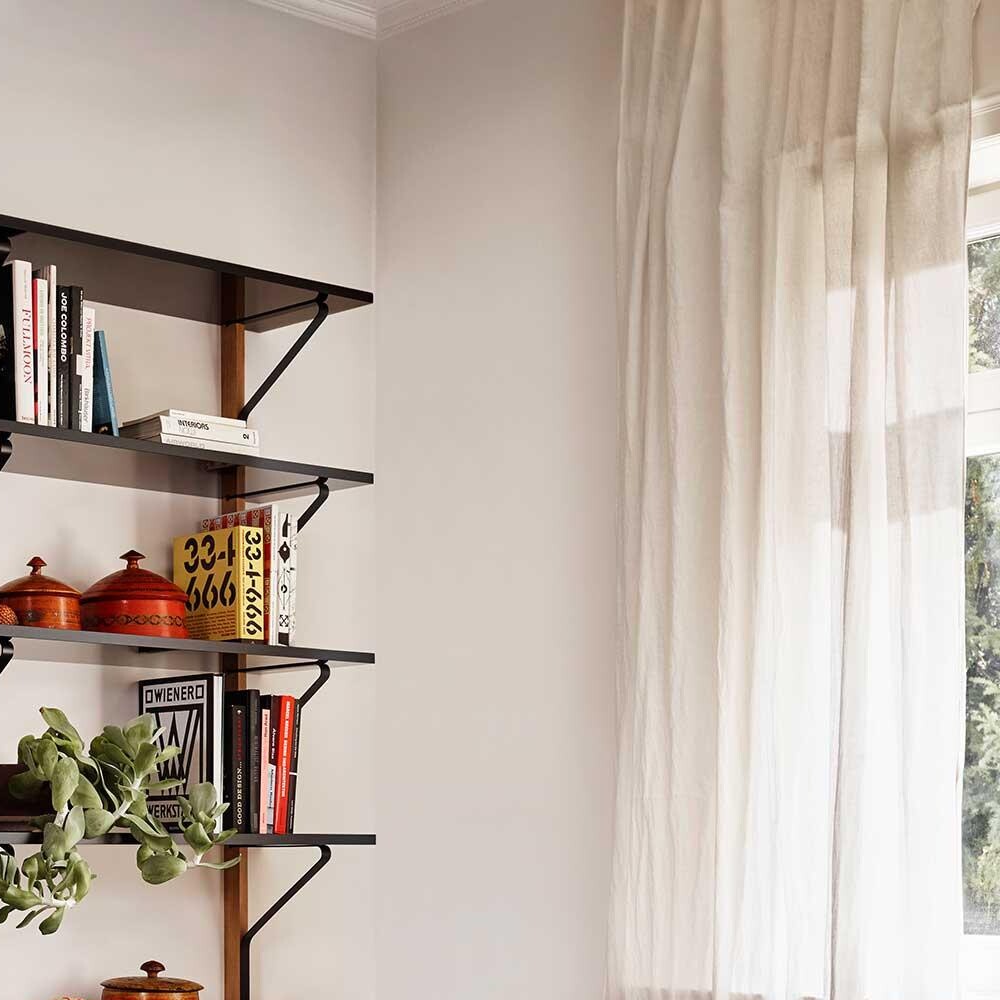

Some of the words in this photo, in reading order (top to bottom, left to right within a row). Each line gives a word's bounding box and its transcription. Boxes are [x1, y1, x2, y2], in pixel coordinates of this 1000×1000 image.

[22, 308, 32, 384] FULLMOON
[178, 419, 209, 430] INTERIORS
[185, 571, 237, 612] 666
[154, 686, 195, 702] WIENER
[147, 804, 184, 819] WERKST
